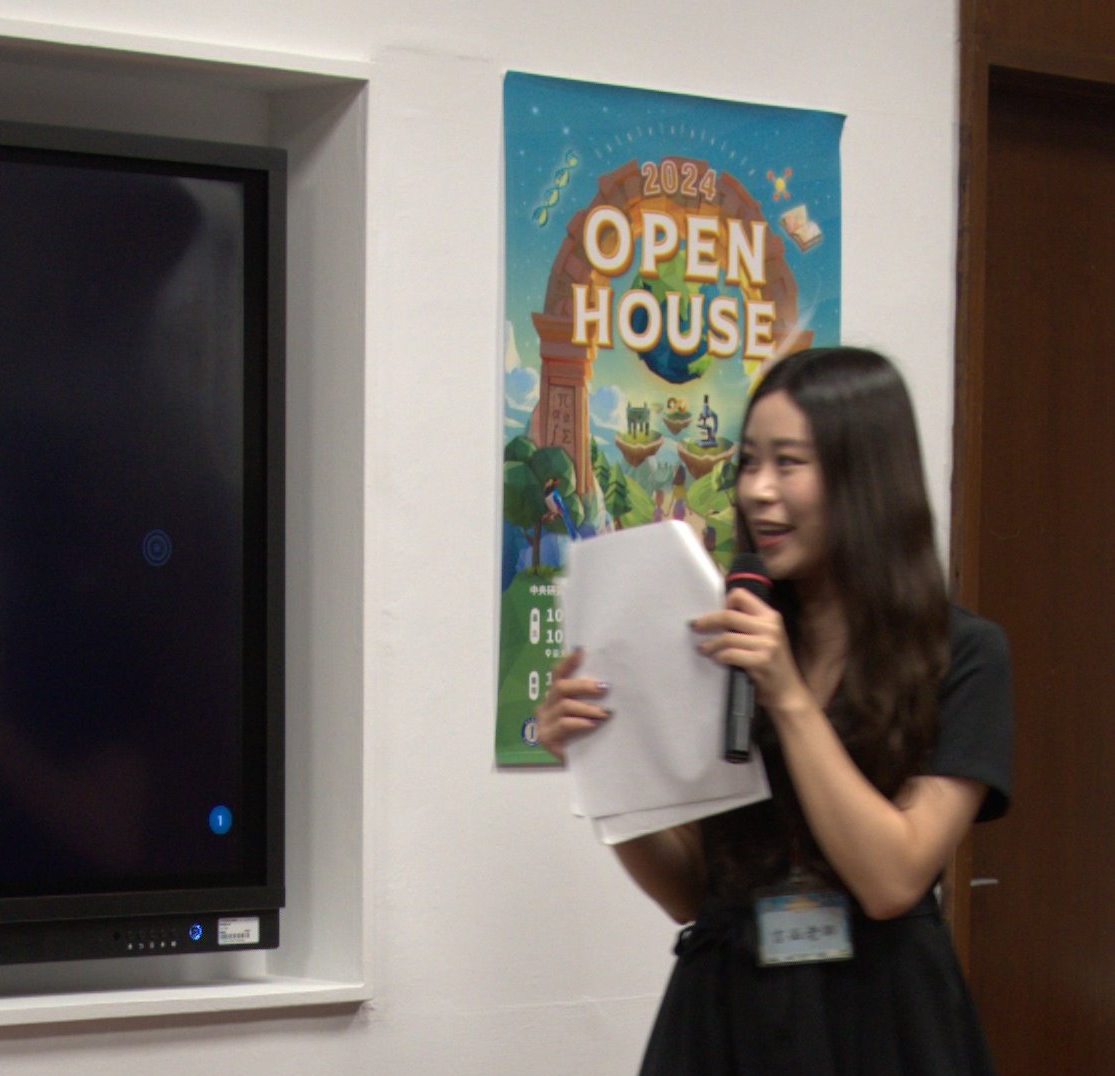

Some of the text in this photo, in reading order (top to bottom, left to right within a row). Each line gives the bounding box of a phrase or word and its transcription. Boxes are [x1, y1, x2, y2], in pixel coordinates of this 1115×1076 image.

[641, 160, 717, 200] 2024
[583, 205, 768, 285] OPEN
[571, 284, 776, 360] HOUSE
